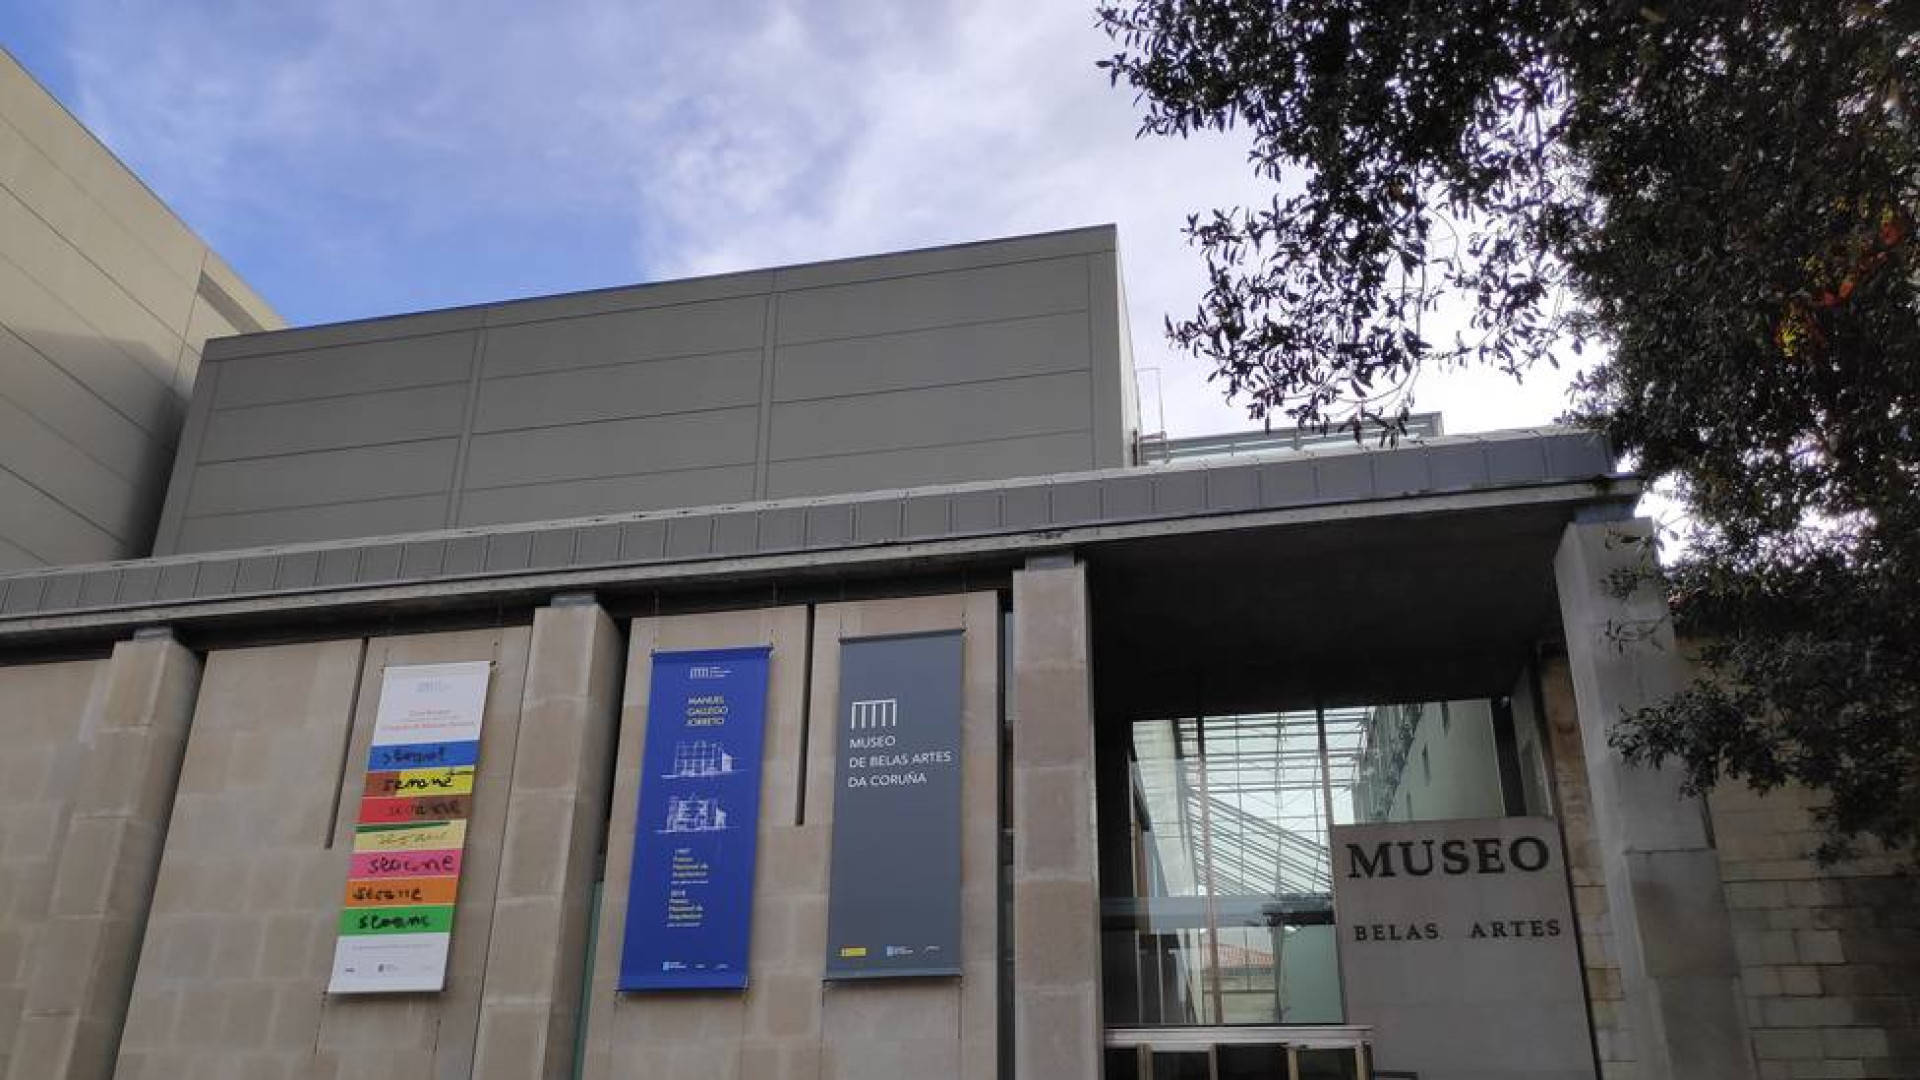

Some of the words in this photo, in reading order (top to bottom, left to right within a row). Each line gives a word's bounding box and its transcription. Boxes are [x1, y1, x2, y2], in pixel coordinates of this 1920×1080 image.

[849, 735, 896, 749] MUSEO
[849, 756, 867, 768] DE
[868, 753, 910, 767] BELAS
[912, 750, 952, 764] ARTES
[847, 775, 868, 788] DA
[869, 770, 928, 786] CORUÑA
[1346, 836, 1549, 878] MUSEO
[1353, 923, 1439, 941] BELAS
[1470, 919, 1561, 939] ARTES
